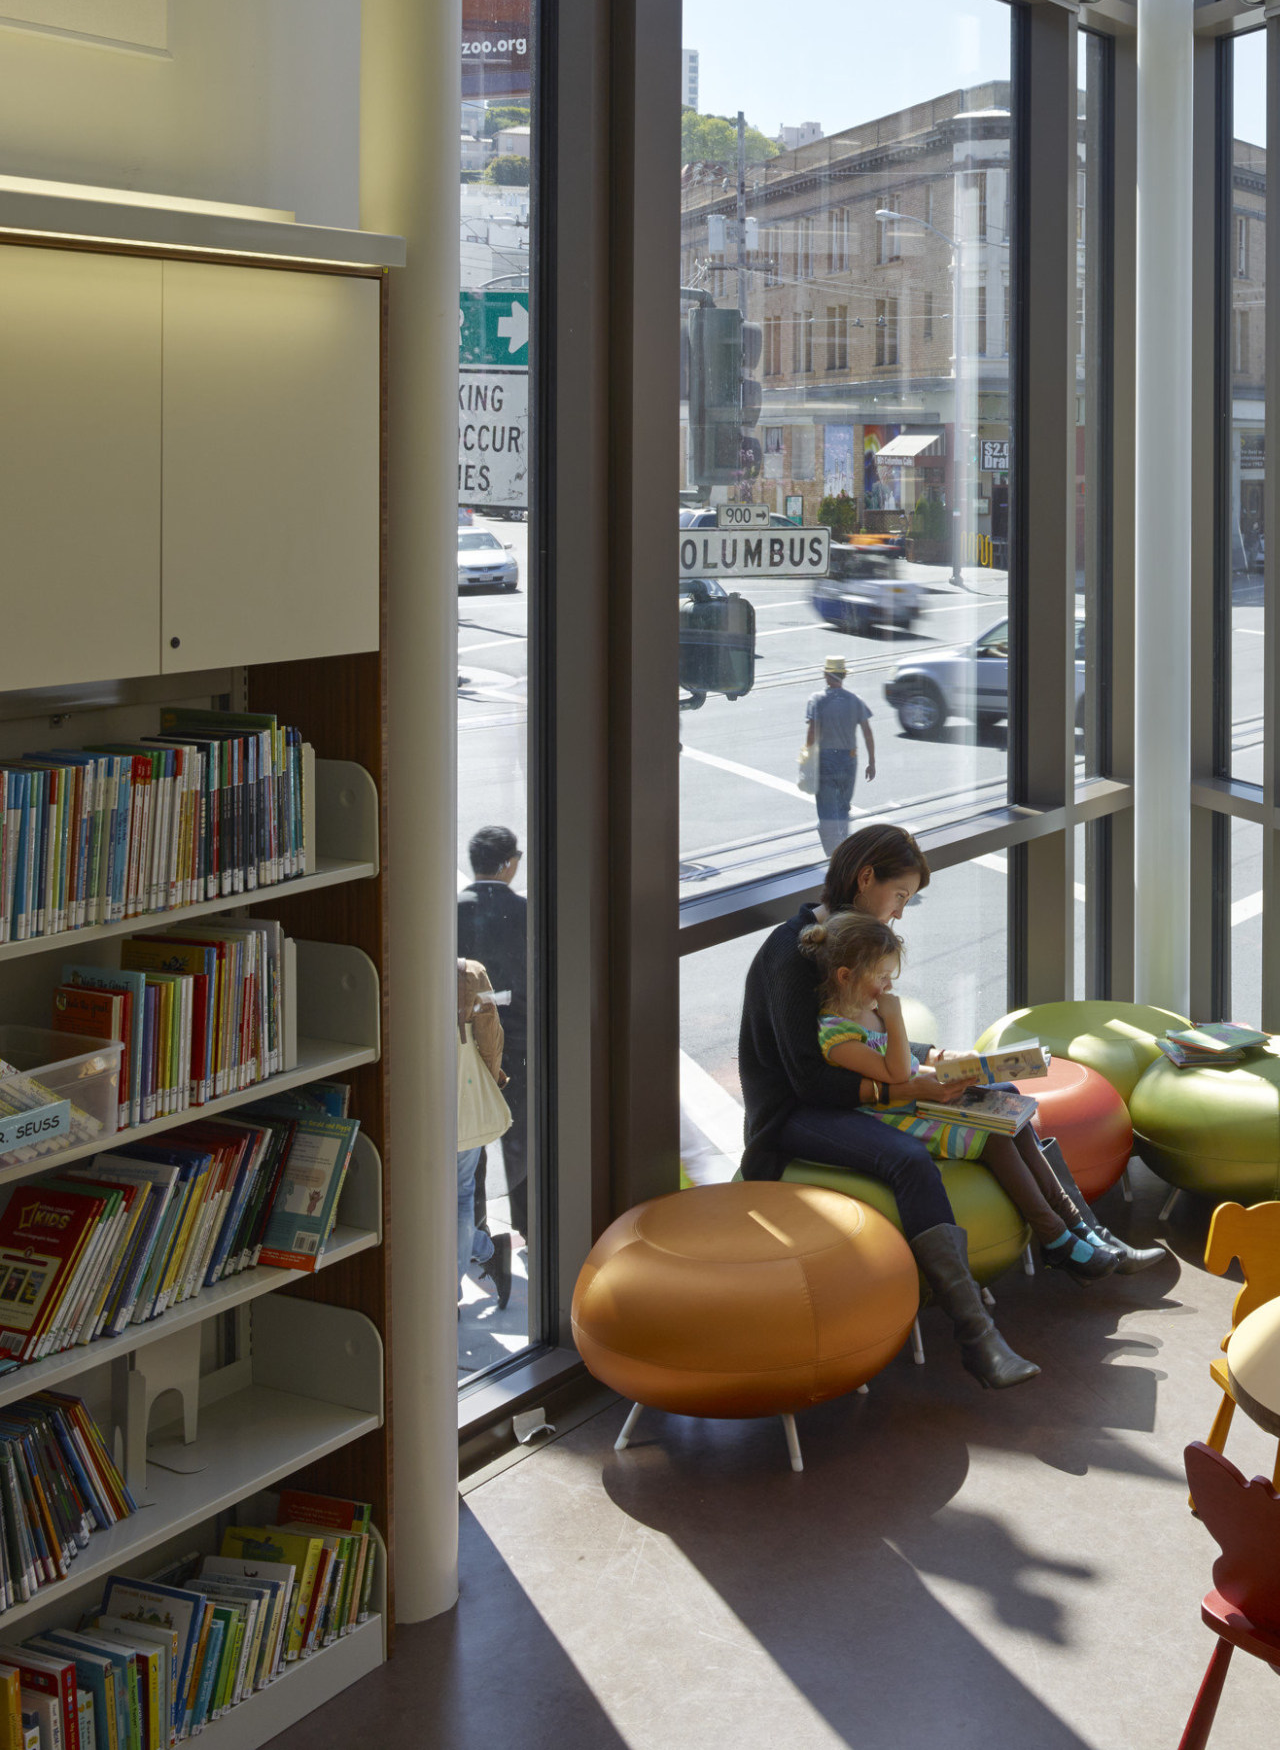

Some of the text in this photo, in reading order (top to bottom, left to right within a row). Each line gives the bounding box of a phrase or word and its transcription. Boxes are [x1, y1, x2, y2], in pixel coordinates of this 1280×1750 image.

[462, 38, 527, 55] zoo.org
[459, 425, 521, 452] CCUR
[726, 508, 752, 523] 900
[681, 537, 823, 570] OLUMBUS
[16, 1115, 60, 1139] SEUSS
[34, 1210, 71, 1229] KIDS
